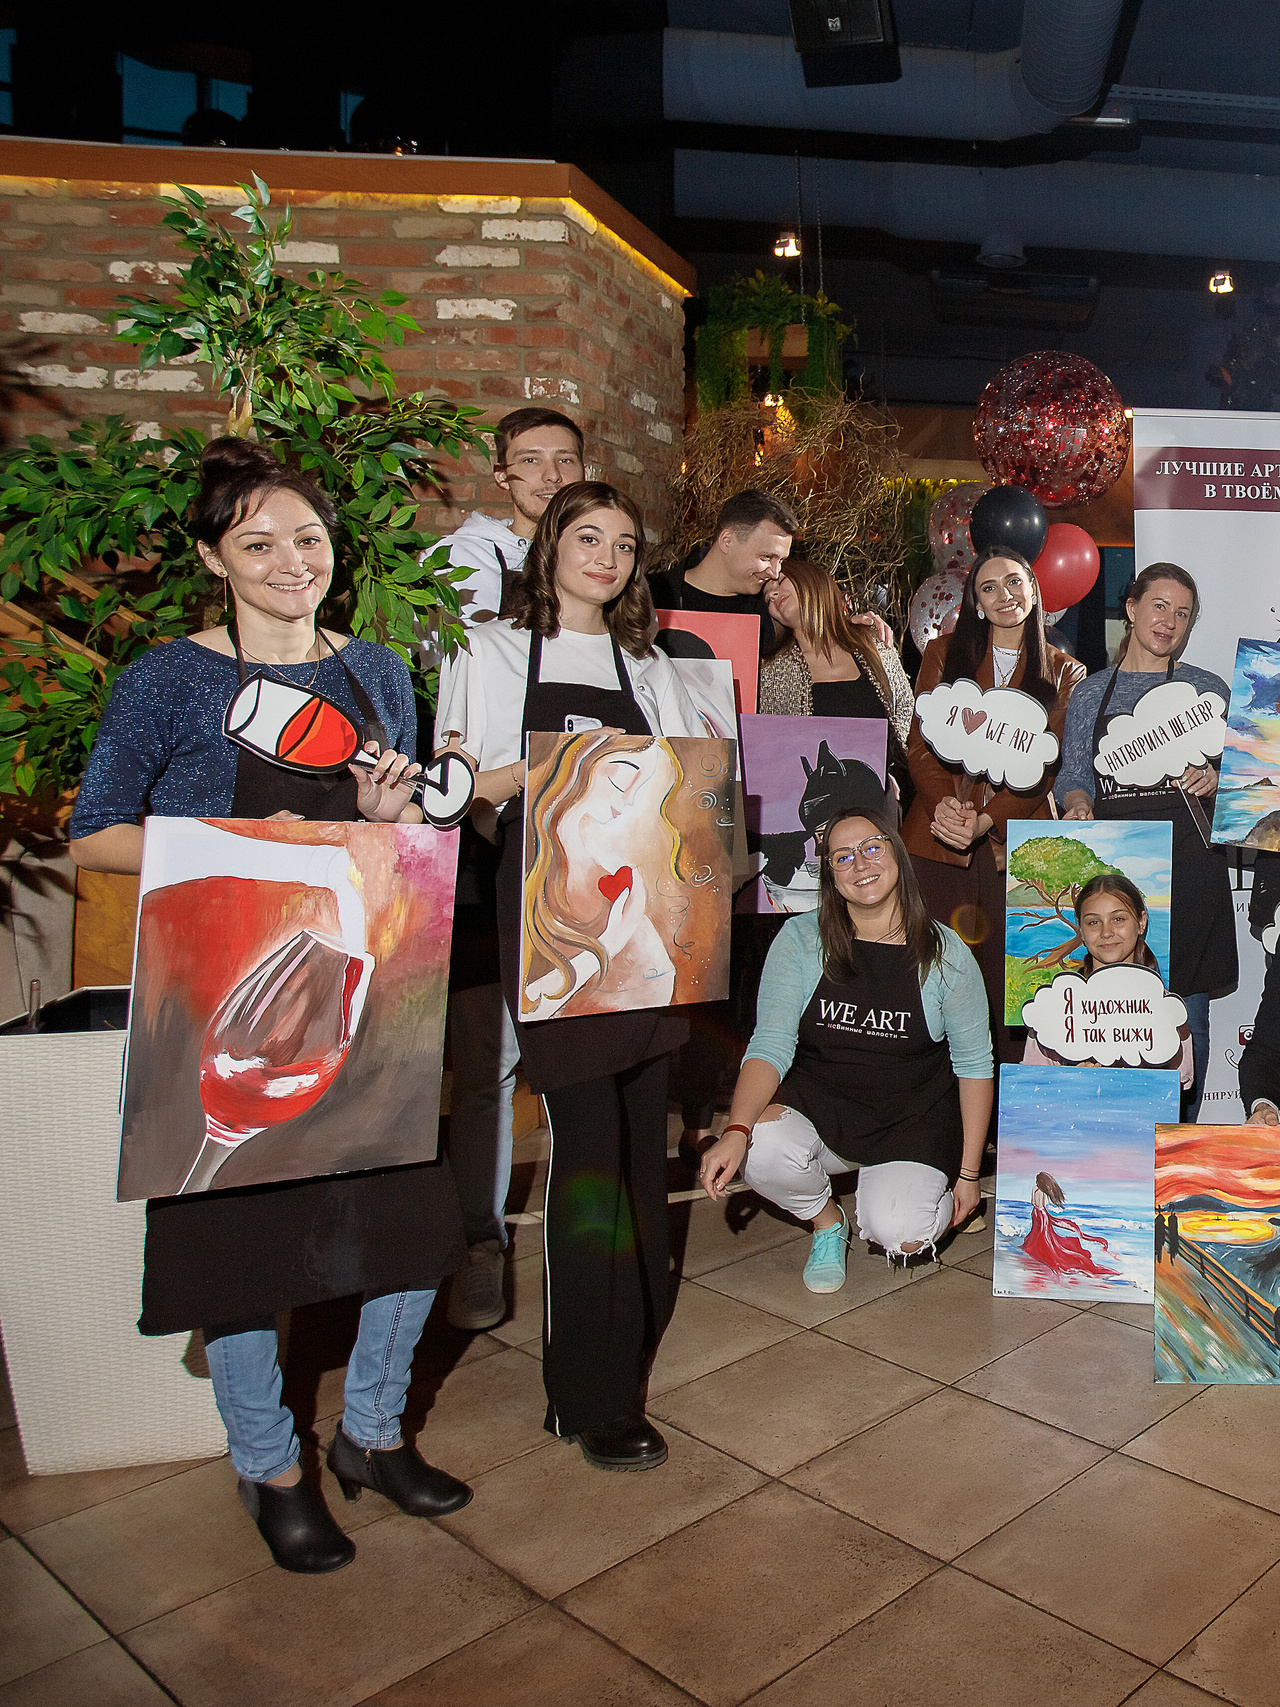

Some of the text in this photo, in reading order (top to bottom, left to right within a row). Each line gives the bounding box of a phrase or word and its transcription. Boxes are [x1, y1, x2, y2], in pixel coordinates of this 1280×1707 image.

[1156, 460, 1246, 477] ЛУЧШИЕ
[1204, 484, 1217, 499] В
[946, 705, 1037, 754] Я WE ART
[1103, 699, 1216, 773] НАТВОРИЛА ШЕДЕВР
[819, 998, 911, 1033] WE ART
[1063, 987, 1153, 1024] Я художник,
[1064, 1016, 1154, 1051] Я так вижу
[1203, 1089, 1240, 1100] НИРУЙ
